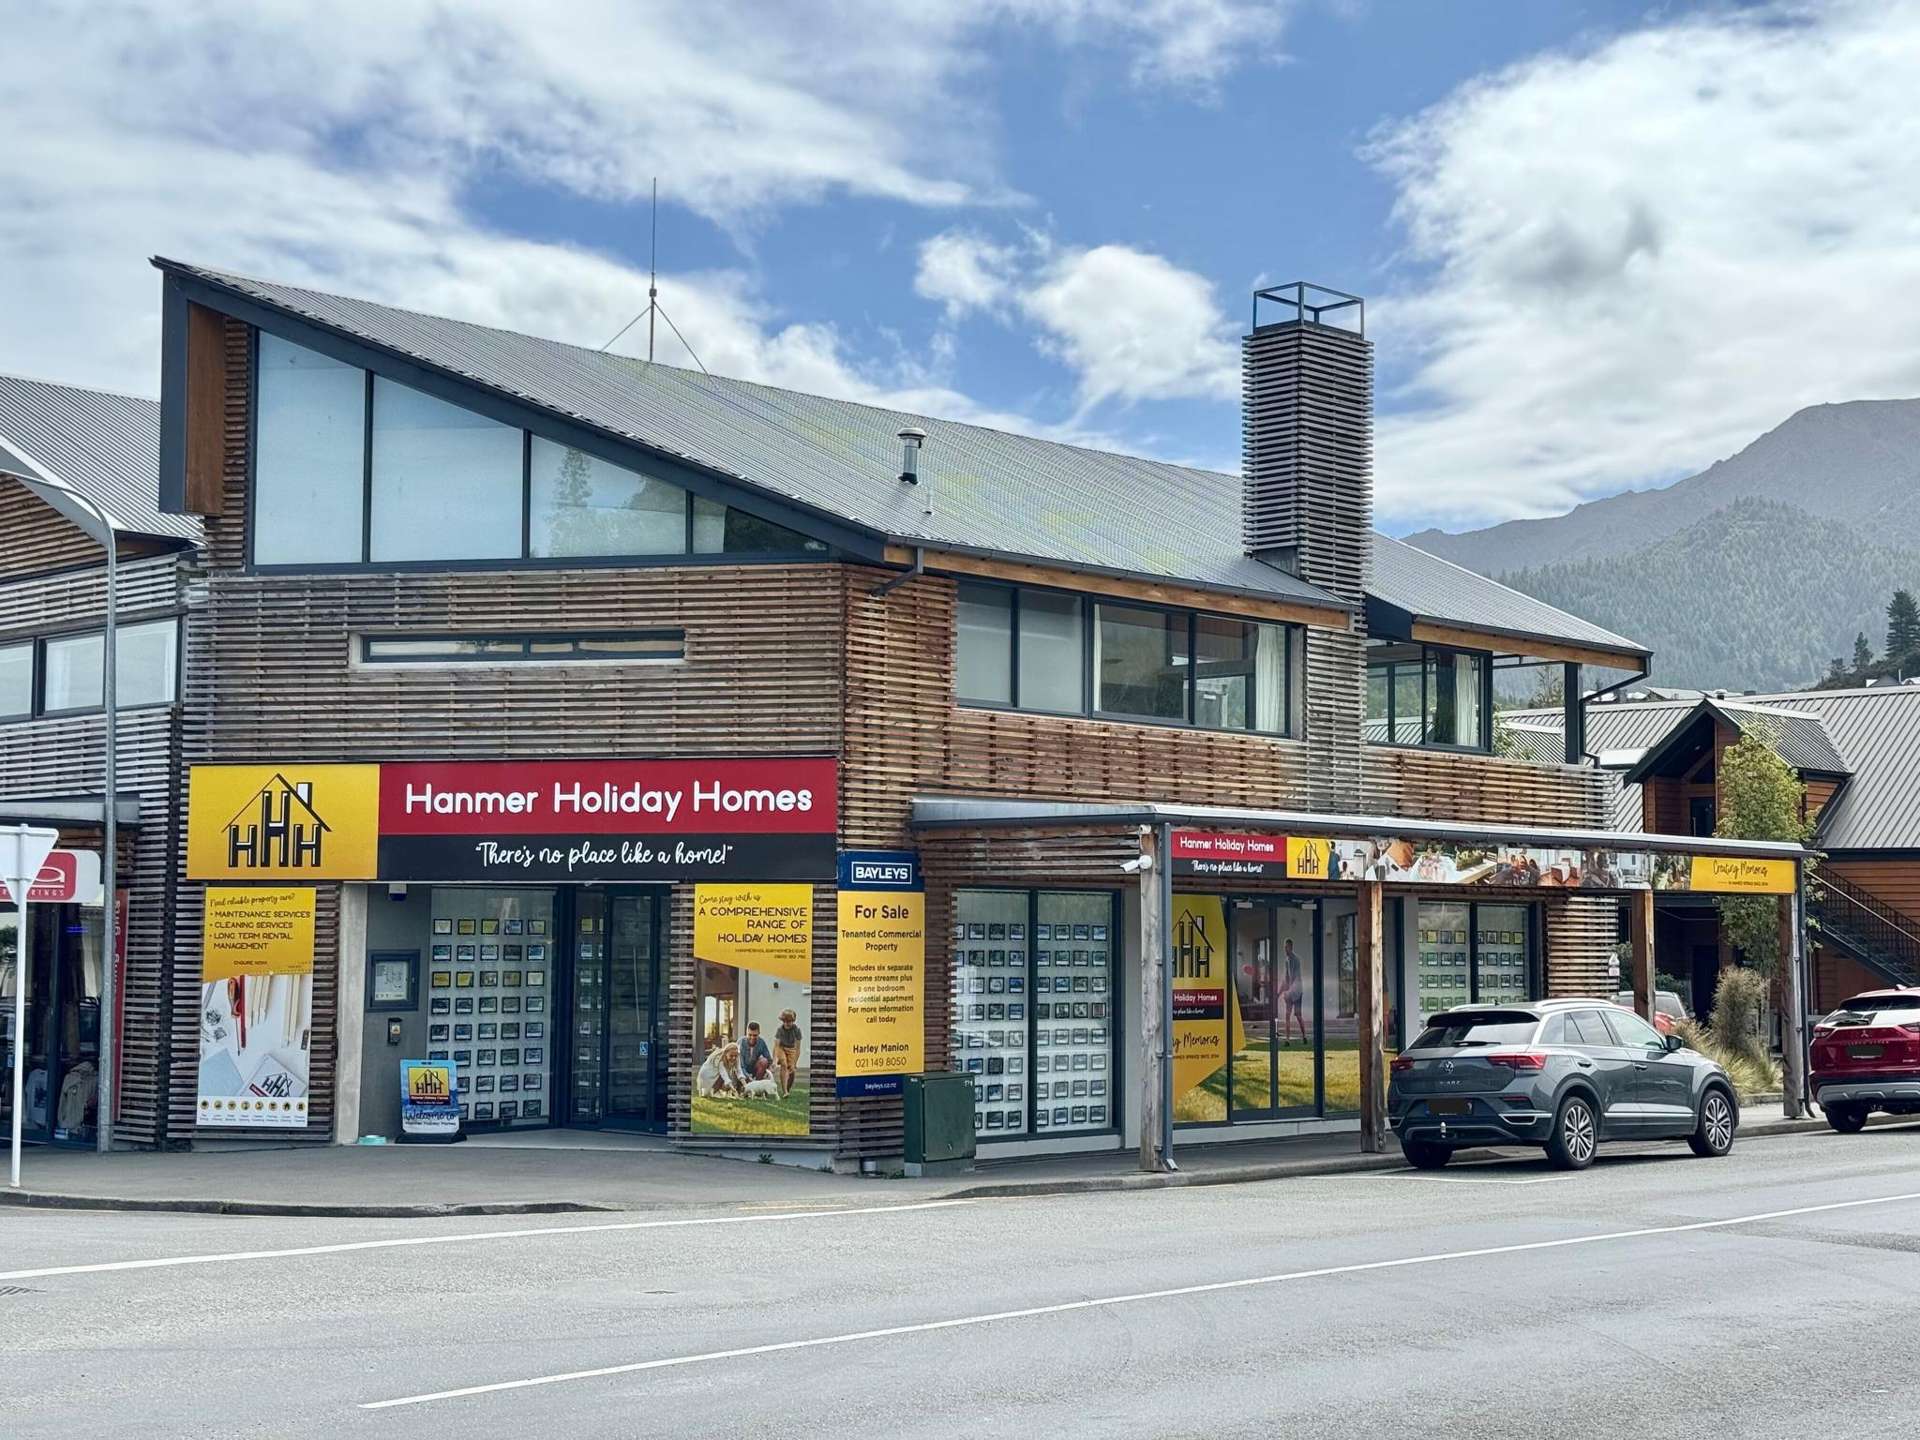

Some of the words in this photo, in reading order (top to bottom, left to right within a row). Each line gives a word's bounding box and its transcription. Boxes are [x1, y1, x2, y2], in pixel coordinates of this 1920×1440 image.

[405, 782, 539, 814] Hanmer
[554, 781, 682, 822] Holiday
[693, 780, 813, 813] Homes
[1180, 837, 1212, 849] Hanmer
[1215, 838, 1244, 854] Holiday
[1247, 839, 1274, 853] Homes
[475, 842, 534, 867] "There's
[539, 851, 564, 866] no
[568, 841, 617, 872] place
[621, 842, 653, 865] like
[657, 852, 671, 865] a
[675, 842, 733, 865] home!"
[855, 866, 909, 880] BAYLEYS
[214, 910, 272, 919] MAINTENANCE
[273, 910, 311, 919] SERVICES
[698, 907, 706, 916] A
[710, 907, 808, 917] COMPREHENSIVE
[854, 904, 878, 919] For
[881, 904, 910, 919] Sale
[214, 921, 254, 929] CLEANING
[255, 921, 294, 929] SERVICES
[747, 919, 786, 929] RANGE
[790, 919, 807, 929] OF
[213, 932, 236, 940] LONG
[238, 932, 261, 940] TERM
[262, 932, 294, 940] RENTAL
[717, 933, 764, 943] HOLIDAY
[767, 933, 808, 944] HOMES
[841, 929, 876, 939] Tenanted
[877, 929, 922, 939] Commercial
[213, 942, 269, 950] MANAGEMENT
[865, 942, 898, 953] Property
[849, 964, 876, 972] Includes
[876, 964, 886, 972] six
[886, 964, 914, 973] separate
[899, 974, 913, 983] plus
[876, 984, 905, 993] bedroom
[848, 995, 881, 1003] residential
[882, 994, 914, 1004] apartment
[1174, 992, 1196, 1004] Holiday
[1197, 992, 1218, 1002] Homes
[847, 1006, 859, 1014] For
[878, 1004, 914, 1013] information
[865, 1016, 878, 1024] call
[878, 1015, 897, 1025] today
[852, 1044, 879, 1055] Harley
[880, 1042, 909, 1053] Manion
[885, 1056, 907, 1067] 8050
